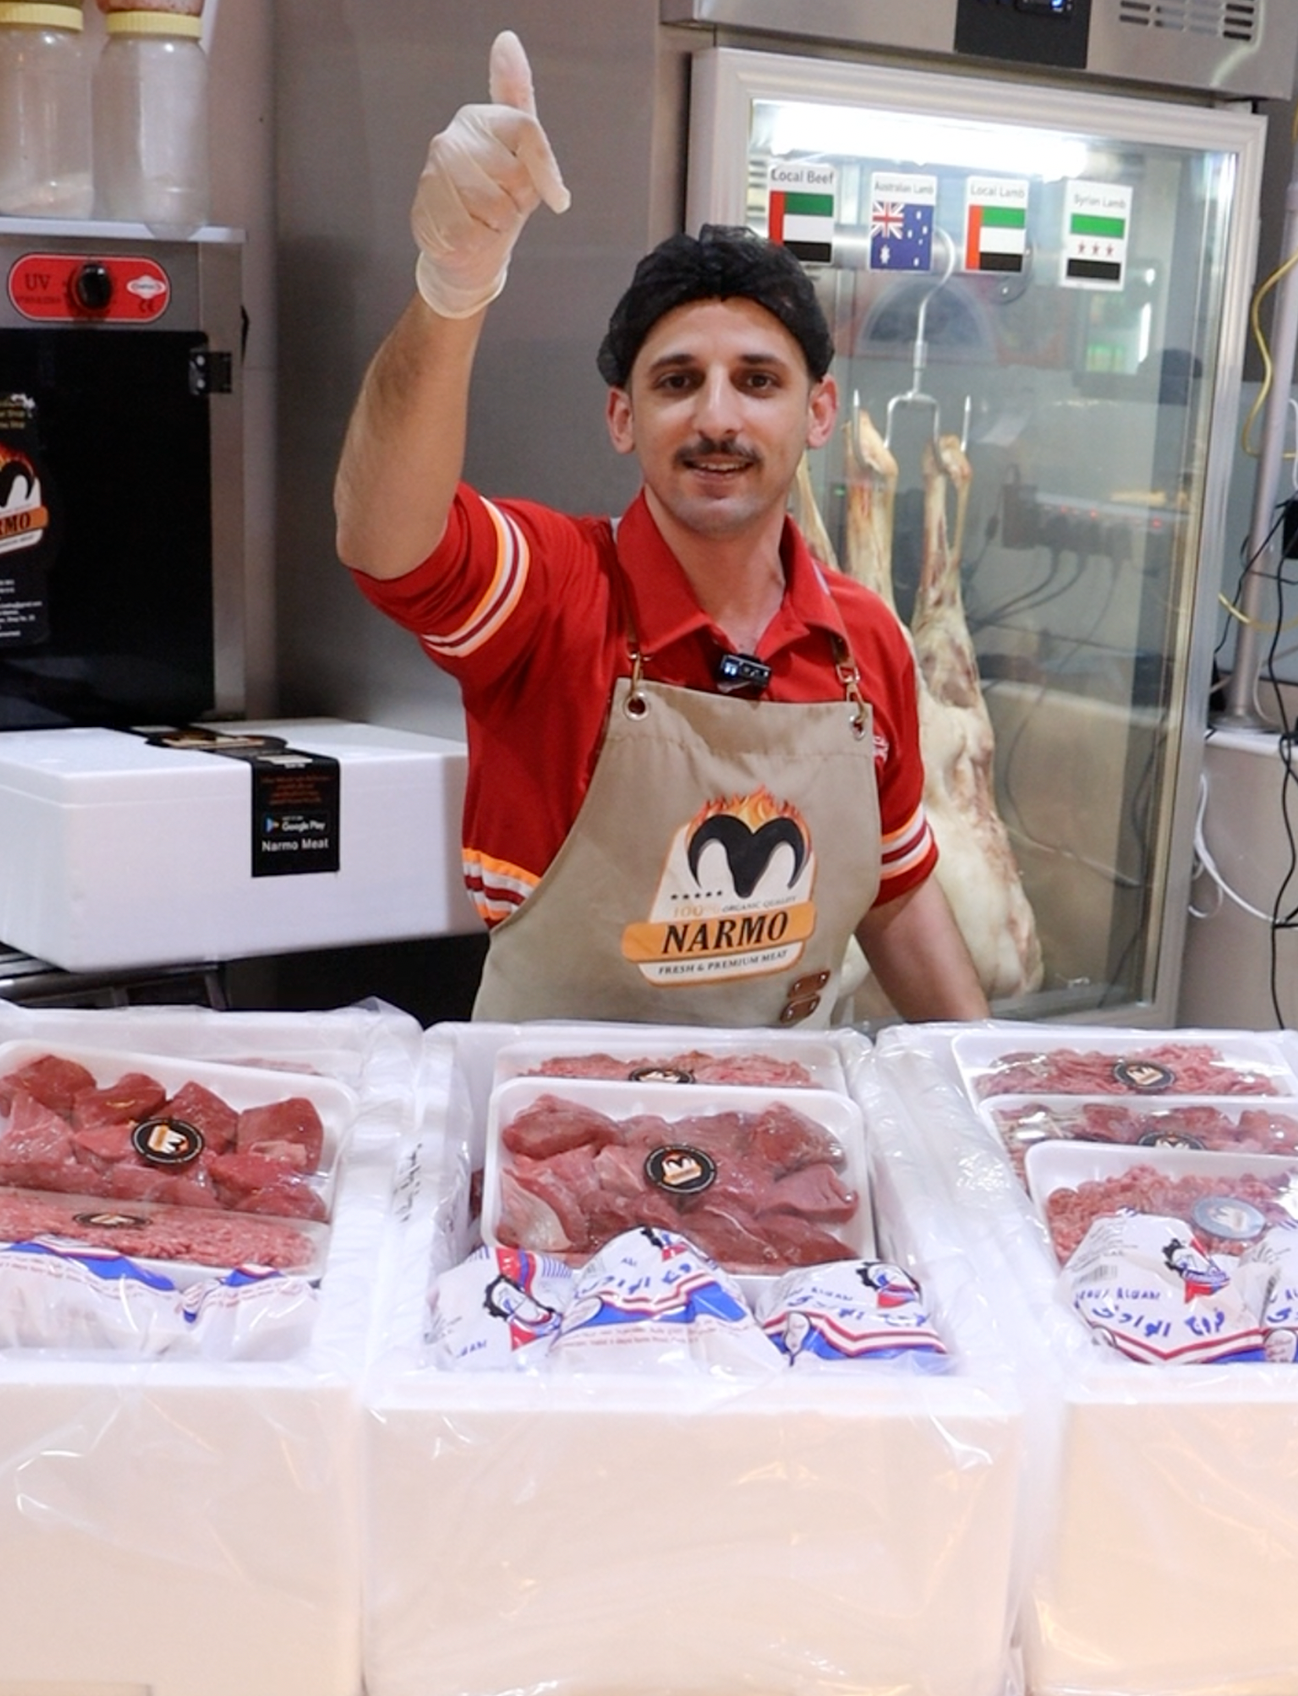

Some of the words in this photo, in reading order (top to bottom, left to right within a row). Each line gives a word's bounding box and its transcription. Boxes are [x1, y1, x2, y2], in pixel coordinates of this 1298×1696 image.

[770, 168, 804, 183] Local
[807, 171, 834, 184] Beef
[874, 181, 911, 193] Australian
[913, 183, 935, 195] Lamb
[970, 184, 997, 196] Local
[1000, 186, 1025, 198] Lamb
[1074, 193, 1100, 207] Syrian
[1102, 197, 1126, 209] Lamb
[25, 273, 51, 291] UV
[261, 840, 299, 852] Narmo
[301, 838, 329, 849] Meat
[721, 902, 760, 914] ORGANIC
[662, 911, 789, 955] NARMO
[658, 963, 694, 976] FRESH
[707, 955, 759, 971] PREMIUM
[761, 950, 788, 963] MEAT
